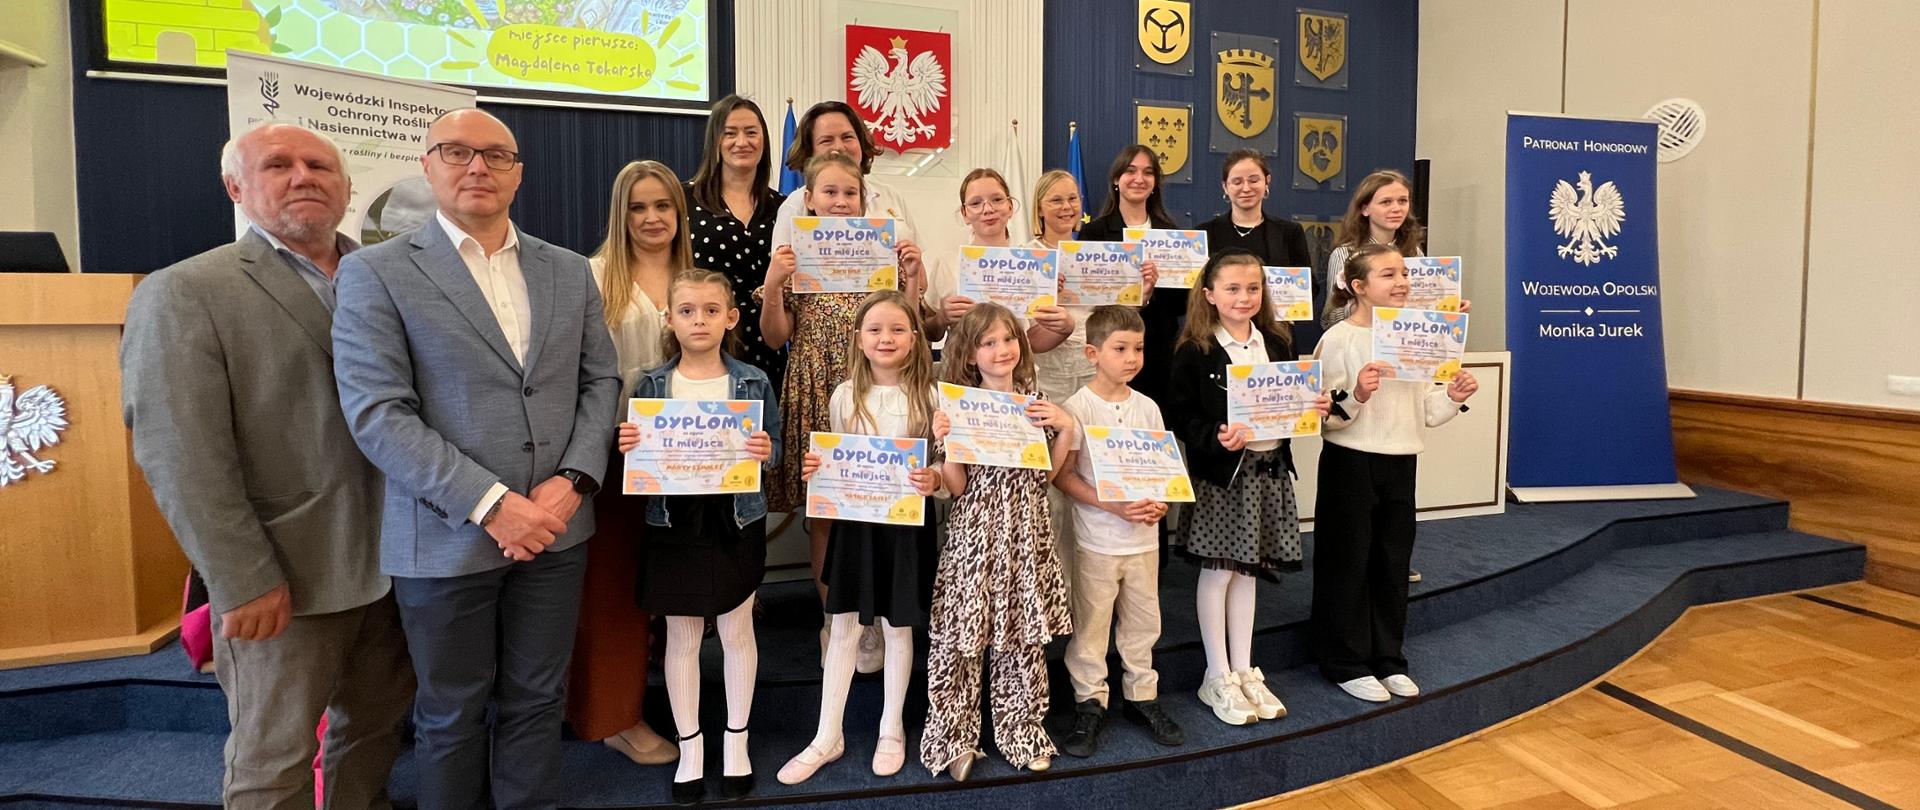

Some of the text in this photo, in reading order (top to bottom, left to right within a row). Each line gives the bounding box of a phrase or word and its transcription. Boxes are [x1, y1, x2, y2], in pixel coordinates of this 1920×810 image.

[509, 29, 639, 51] miejsce pierwsze:
[495, 53, 653, 79] Magdalena Tokarska
[294, 83, 385, 108] Wojewódzki
[327, 105, 389, 127] Ochrony
[308, 118, 407, 141] Nasiennictwa
[411, 134, 422, 142] w
[349, 149, 382, 160] rośliny
[813, 230, 878, 241] DYPLOM
[819, 247, 870, 257] III miejsca
[1076, 253, 1128, 262] DYPLOM
[978, 258, 1040, 271] DYPLOM
[1392, 320, 1450, 335] DYPLOM
[1539, 323, 1643, 338] Monika Jurek
[1247, 374, 1305, 389] DYPLOM
[960, 400, 1023, 416] DYPLOM
[654, 415, 738, 430] DYPLOM
[662, 438, 724, 449] II miejsca
[1106, 439, 1163, 452] DYPLOM
[832, 448, 904, 465] DYPLOM
[840, 469, 891, 481] II miejsca
